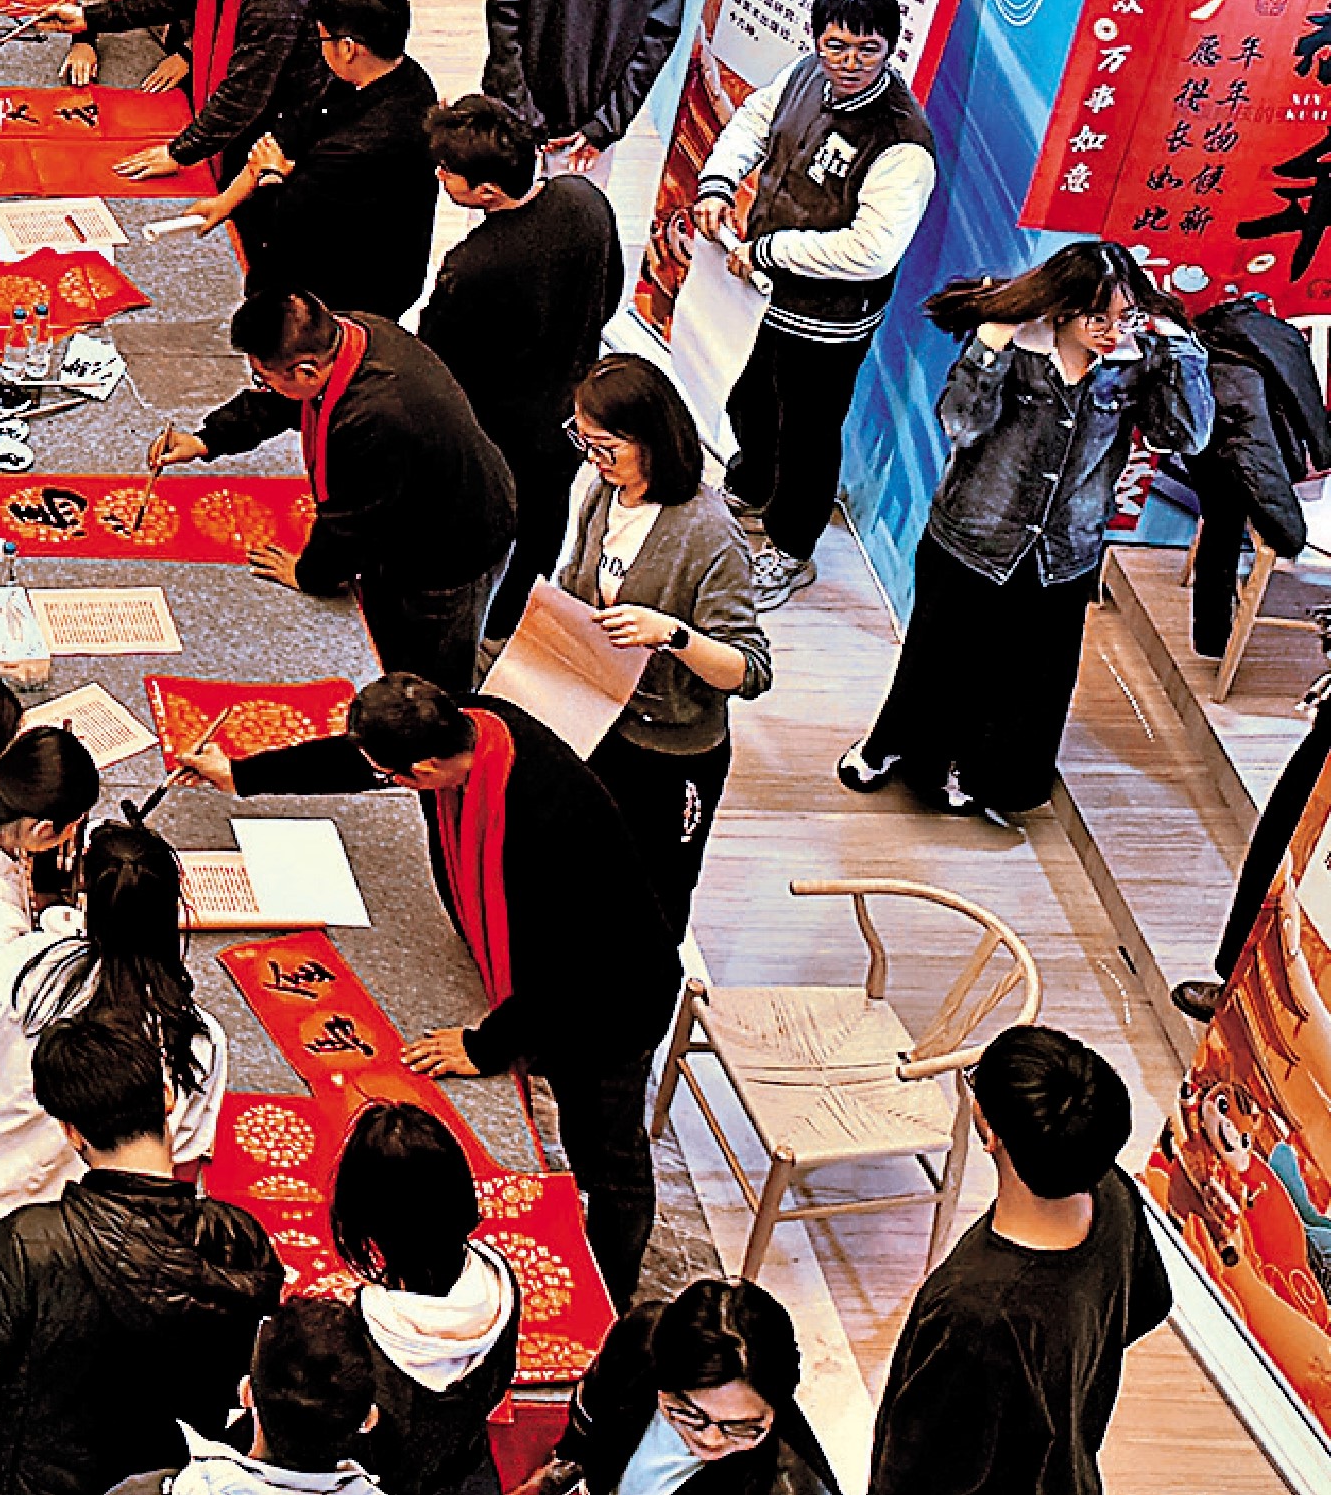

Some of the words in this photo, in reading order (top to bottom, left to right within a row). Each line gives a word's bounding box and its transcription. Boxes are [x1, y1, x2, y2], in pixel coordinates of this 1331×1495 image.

[1059, 44, 1134, 193] 万事如意
[1178, 35, 1264, 235] 年年物候新
